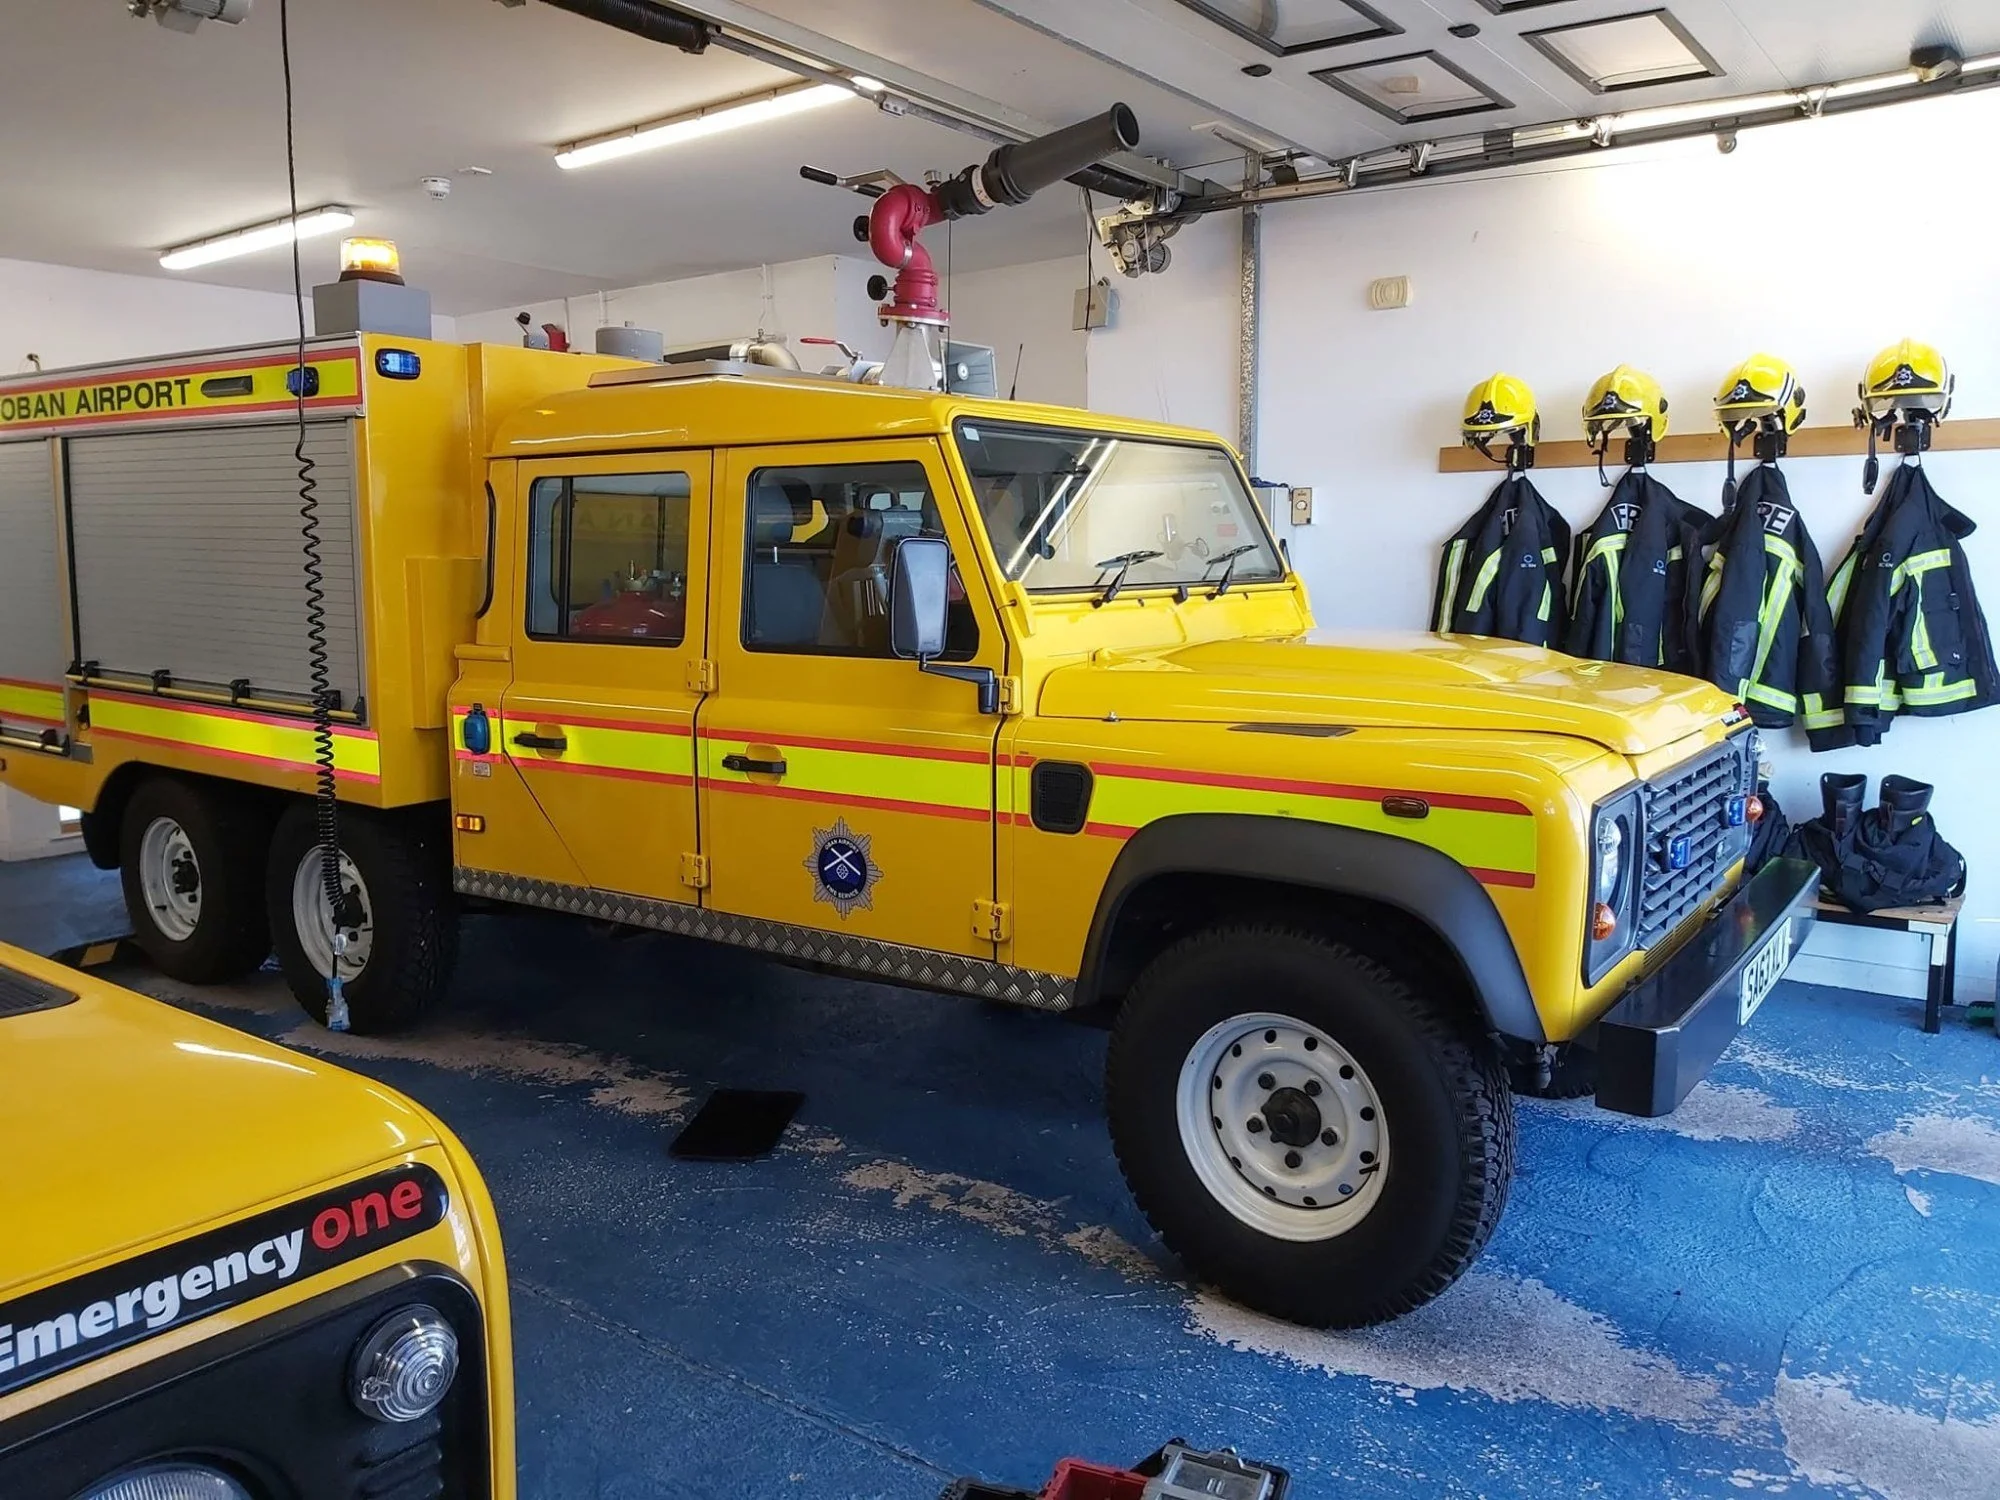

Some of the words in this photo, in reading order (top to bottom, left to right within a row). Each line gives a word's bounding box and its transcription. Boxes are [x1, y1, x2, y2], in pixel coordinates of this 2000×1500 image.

[1, 391, 65, 421] OBAN
[75, 378, 191, 414] AIRPORT
[311, 1179, 423, 1251] one
